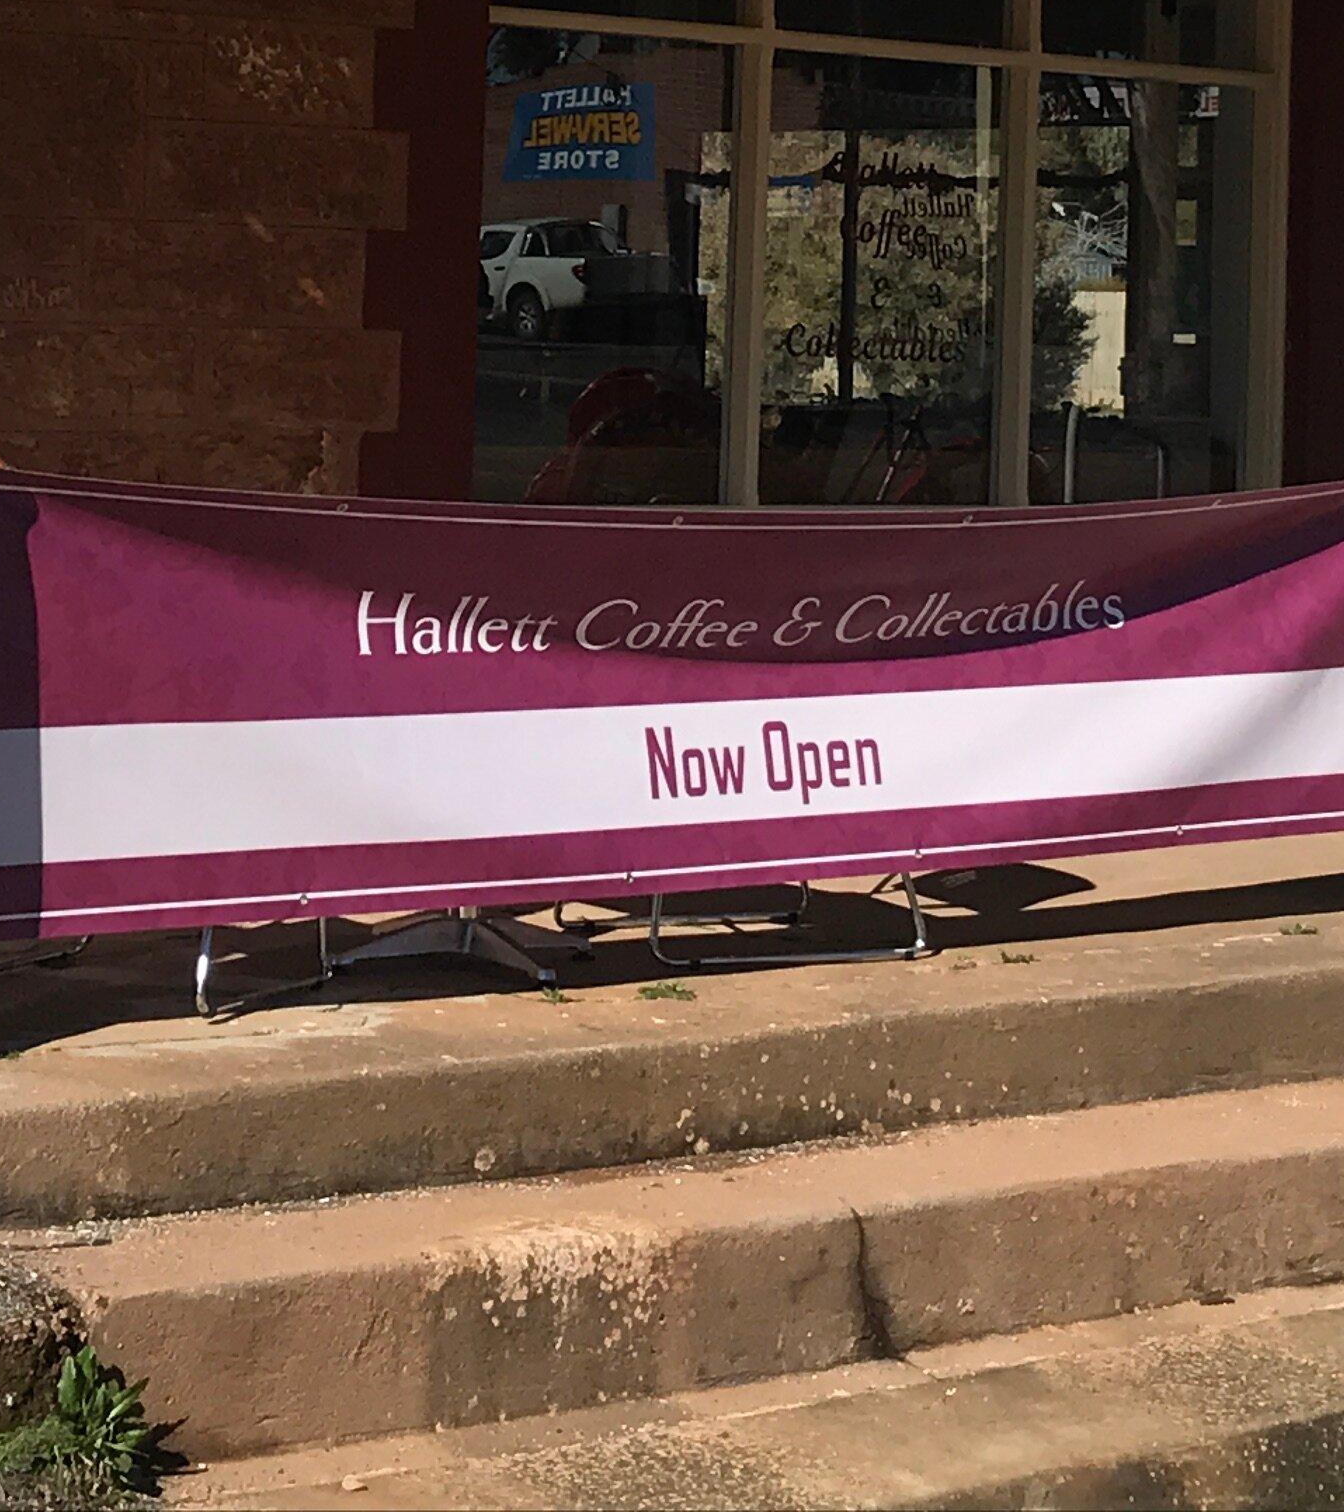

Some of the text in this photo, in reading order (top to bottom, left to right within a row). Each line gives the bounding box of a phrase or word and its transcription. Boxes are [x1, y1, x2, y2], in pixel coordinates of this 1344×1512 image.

[840, 208, 927, 259] offee
[774, 322, 966, 363] Colectables
[357, 579, 1125, 656] Hallett Coffee & Collectables
[644, 720, 883, 805] Now Open
